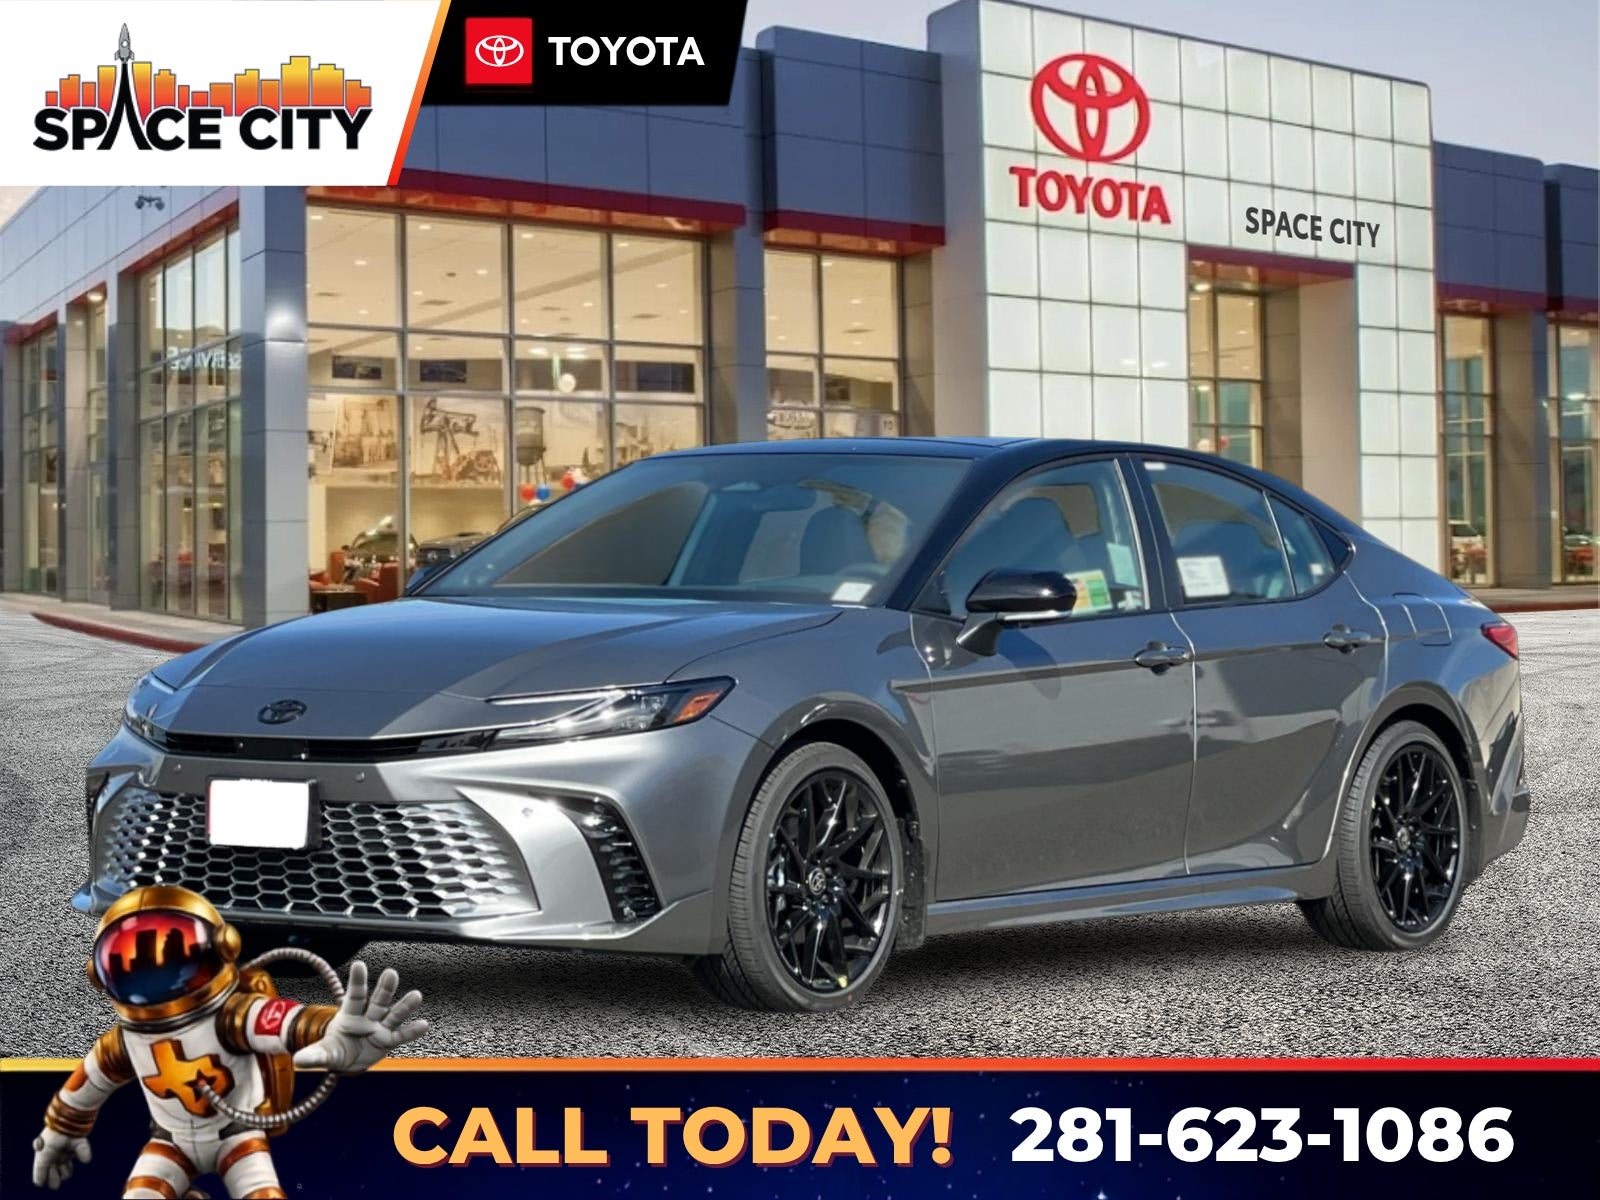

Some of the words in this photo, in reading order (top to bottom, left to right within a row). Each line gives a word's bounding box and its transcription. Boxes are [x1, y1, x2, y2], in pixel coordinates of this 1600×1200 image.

[1009, 166, 1171, 225] TOYOTA
[1245, 206, 1323, 242] SPACE
[1329, 218, 1381, 248] CITY
